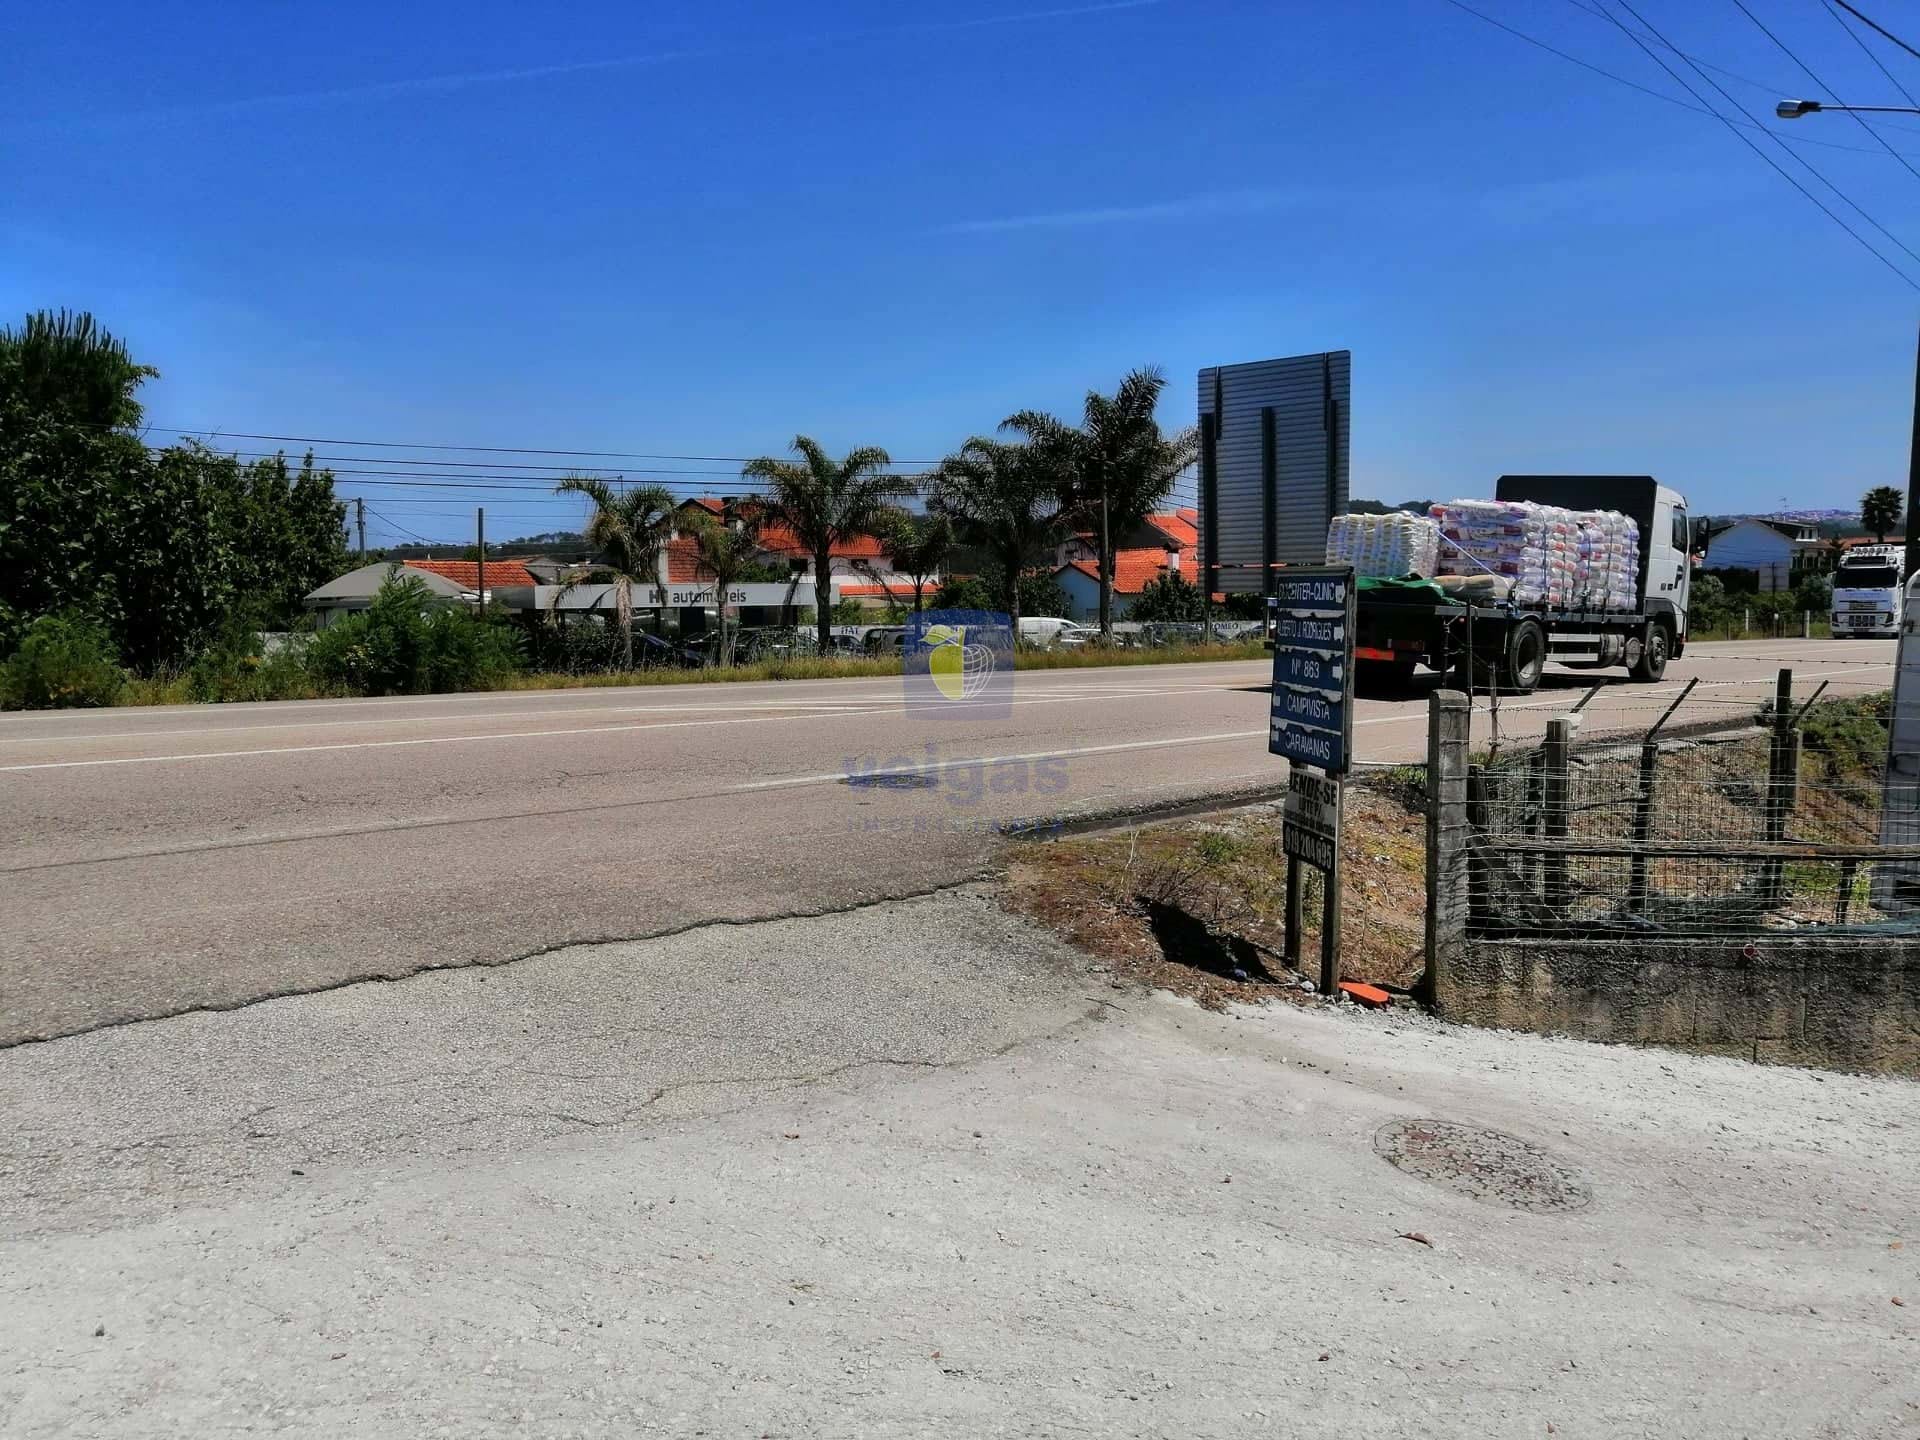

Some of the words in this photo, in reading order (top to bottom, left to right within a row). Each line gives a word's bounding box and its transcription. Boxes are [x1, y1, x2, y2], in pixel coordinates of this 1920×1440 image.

[672, 588, 747, 603] automeis
[1302, 621, 1332, 640] RODRIGUES
[1303, 660, 1320, 679] 863
[1287, 694, 1331, 720] CAMPIVISTA
[1285, 731, 1331, 760] CARAVANAS
